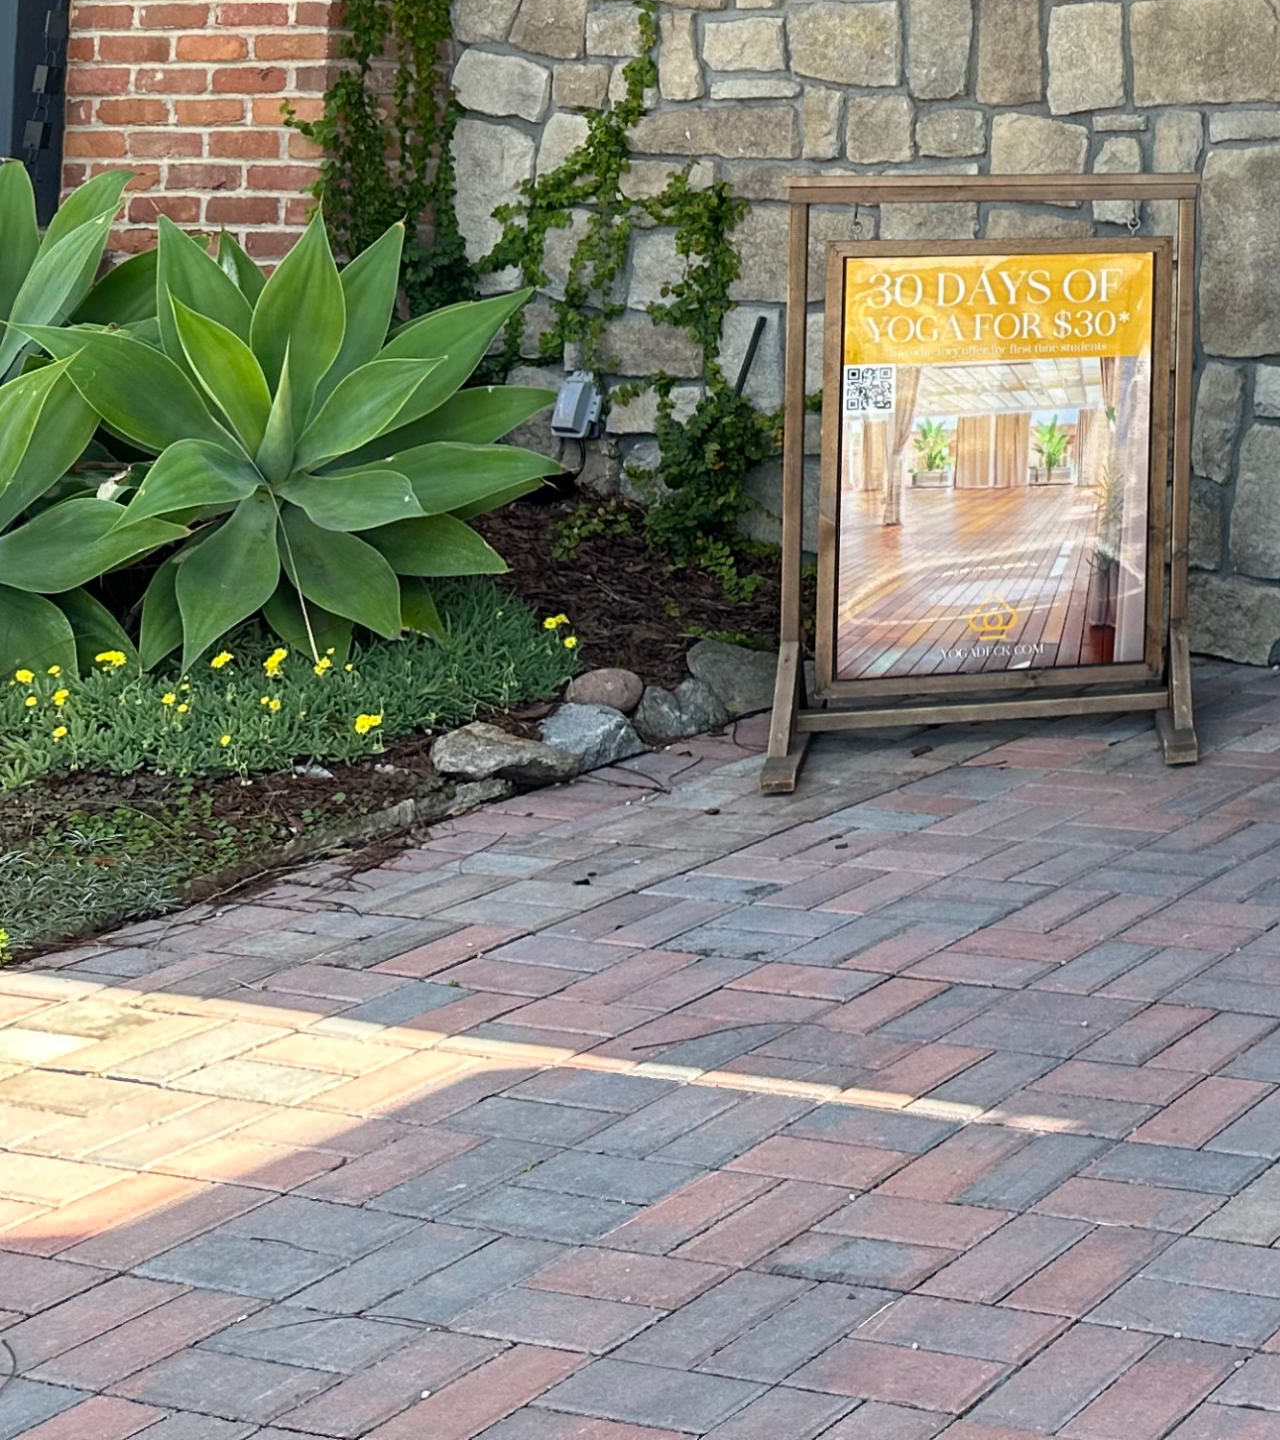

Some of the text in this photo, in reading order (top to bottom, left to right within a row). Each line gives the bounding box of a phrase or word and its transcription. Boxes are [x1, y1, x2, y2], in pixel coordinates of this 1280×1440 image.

[866, 268, 1124, 310] 30 DAYS OF
[866, 315, 965, 343] YOGA
[973, 312, 1048, 341] FOR
[1009, 344, 1032, 354] first
[1060, 342, 1108, 352] students
